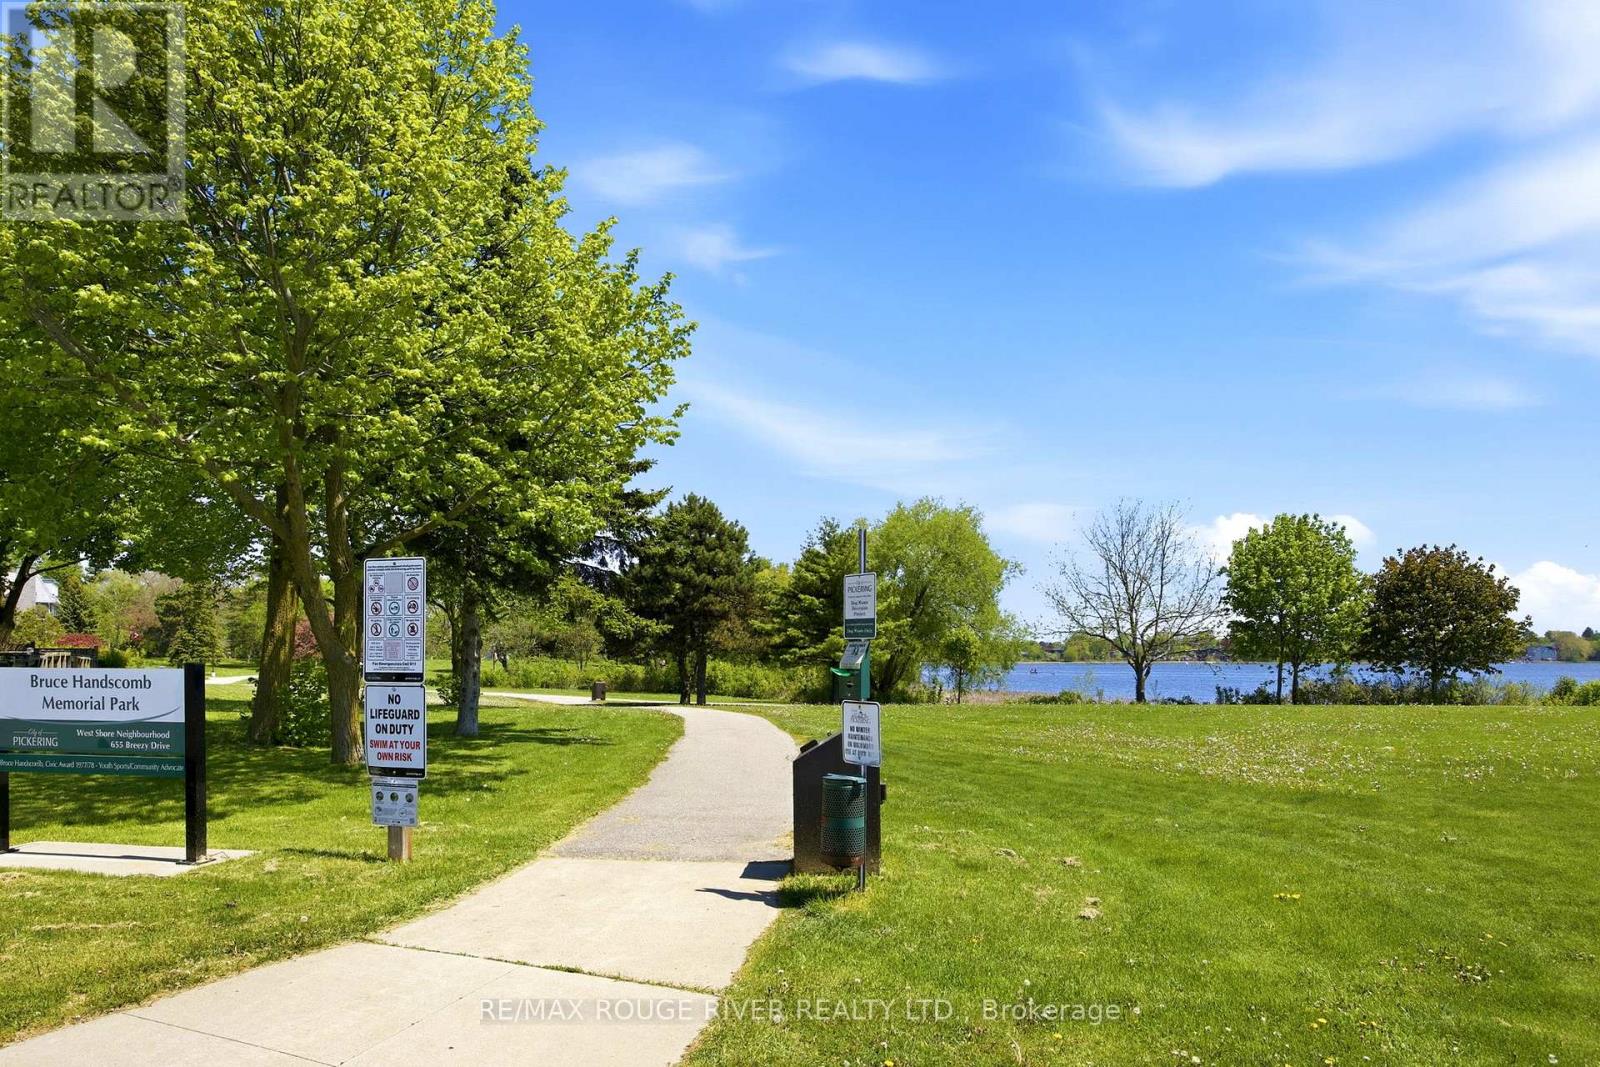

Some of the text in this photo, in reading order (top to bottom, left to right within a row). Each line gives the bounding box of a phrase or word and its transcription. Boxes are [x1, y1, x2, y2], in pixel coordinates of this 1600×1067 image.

[30, 674, 151, 689] Bruce Handscomb
[42, 696, 139, 711] Memorial Park
[388, 694, 401, 704] NO
[370, 708, 420, 720] LIFEGUARD
[77, 729, 170, 739] West Shore Neighbourhood
[375, 723, 414, 735] ON DUTY
[13, 736, 58, 747] PICKERING
[110, 741, 170, 751] 655 Breezy Drive
[370, 740, 421, 750] SWIM AT YOUR
[377, 752, 412, 761] OWN RISK
